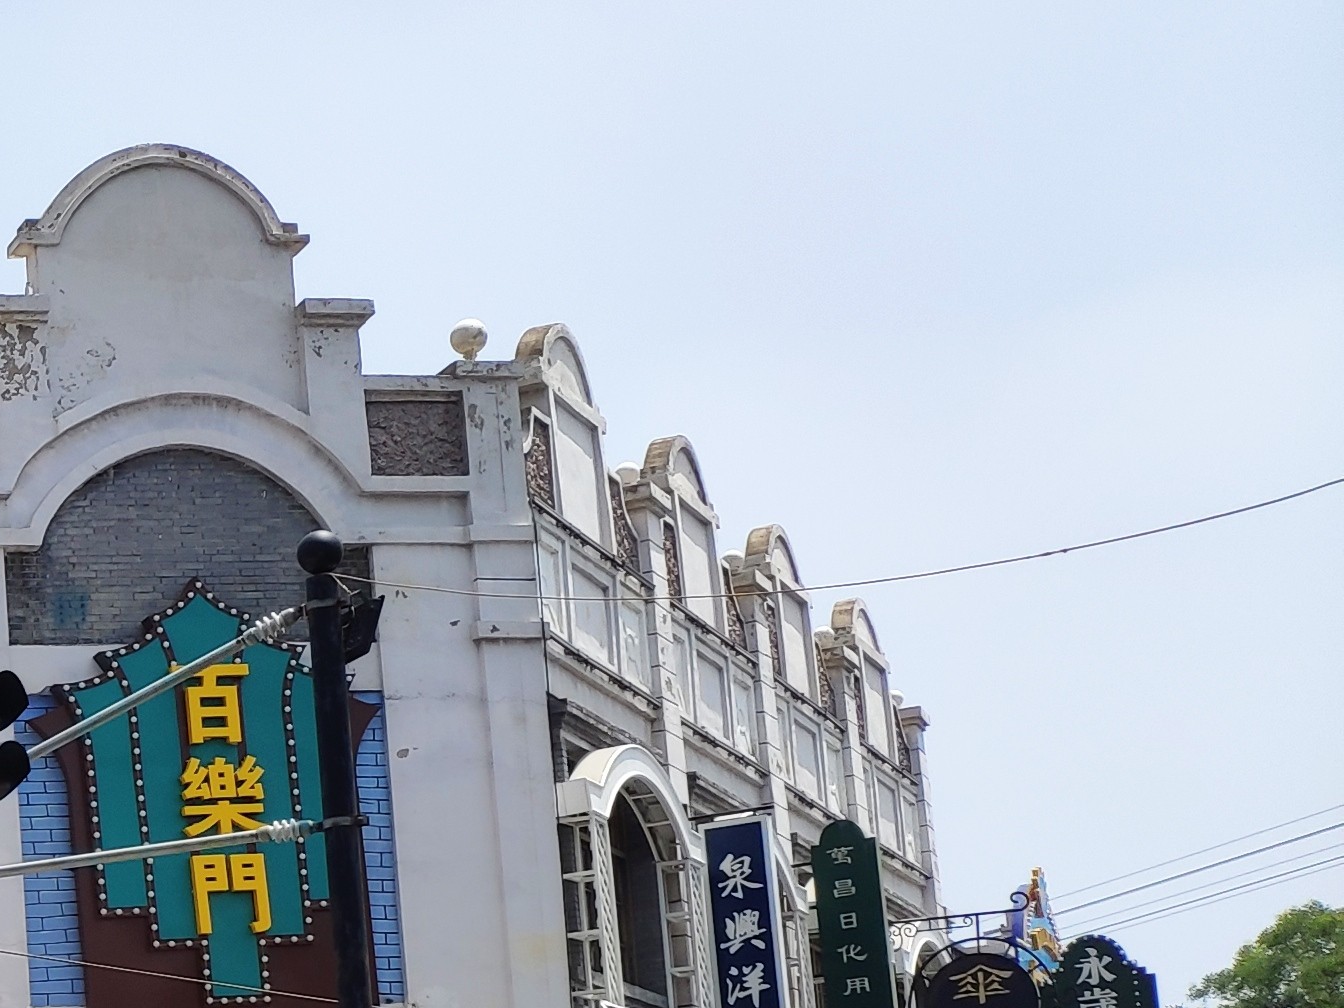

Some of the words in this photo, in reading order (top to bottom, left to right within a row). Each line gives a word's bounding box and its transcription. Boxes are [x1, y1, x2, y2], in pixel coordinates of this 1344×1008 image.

[169, 663, 272, 935] 百樂門
[717, 853, 771, 1008] 泉興洋
